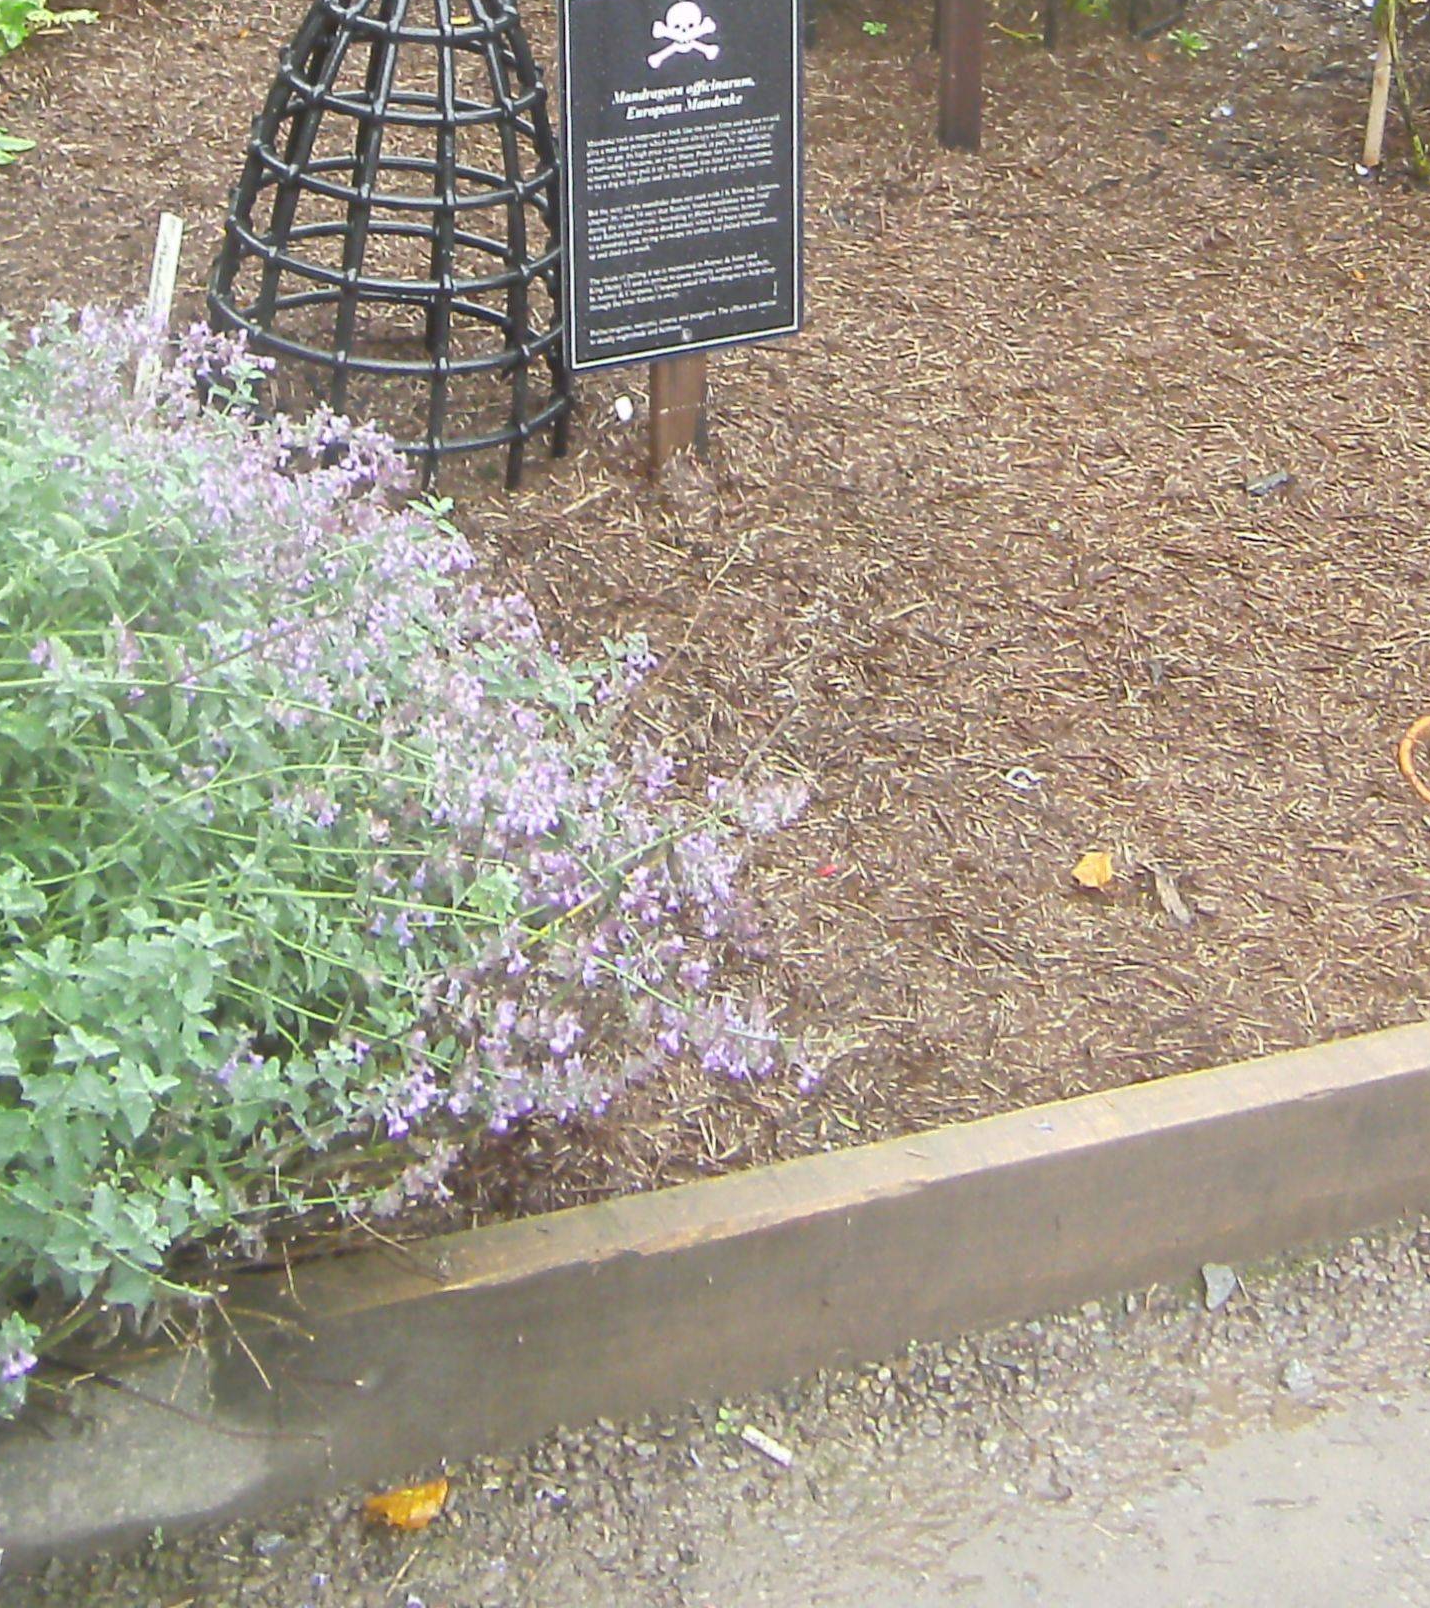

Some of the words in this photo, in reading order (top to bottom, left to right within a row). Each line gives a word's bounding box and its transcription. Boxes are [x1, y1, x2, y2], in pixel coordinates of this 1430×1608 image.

[612, 86, 684, 106] Mandragora
[625, 102, 682, 120] European
[684, 92, 744, 112] Mandrake
